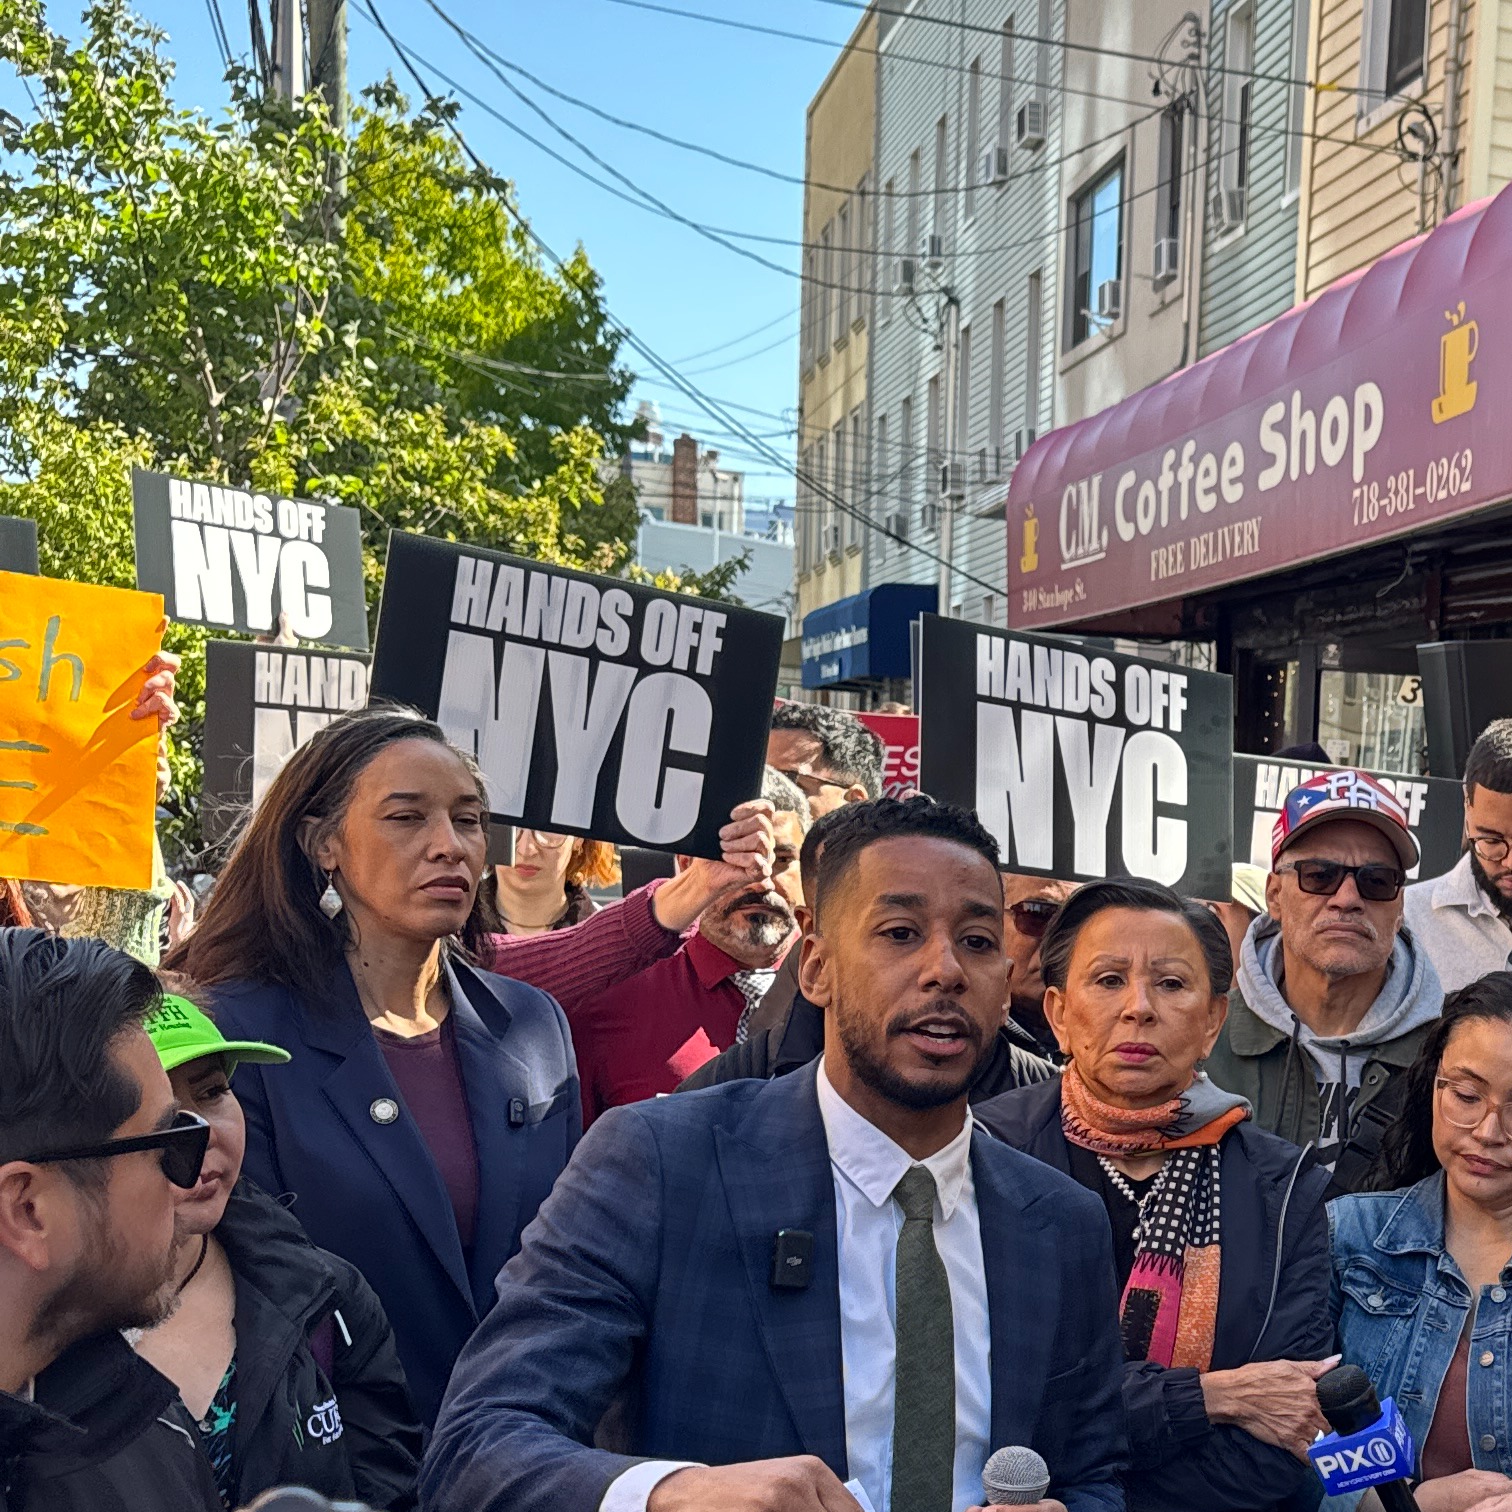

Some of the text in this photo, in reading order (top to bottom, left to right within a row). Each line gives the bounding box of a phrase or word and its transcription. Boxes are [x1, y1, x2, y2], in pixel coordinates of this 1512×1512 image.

[1114, 439, 1245, 542] Coffee
[1257, 381, 1385, 491] Shop
[1351, 448, 1473, 527] 718-381-0262
[168, 478, 327, 544] HANDS OFF
[1151, 515, 1263, 582] FREE DELIVERY
[170, 519, 333, 639] NYC
[450, 555, 635, 657] HANDS
[640, 598, 728, 676] OFF
[255, 651, 371, 712] HAND
[976, 633, 1188, 732] HANDS OFF
[437, 629, 713, 845] NYC
[976, 701, 1188, 887] NYC
[1384, 777, 1429, 827] FF
[1314, 1445, 1376, 1479] PIX
